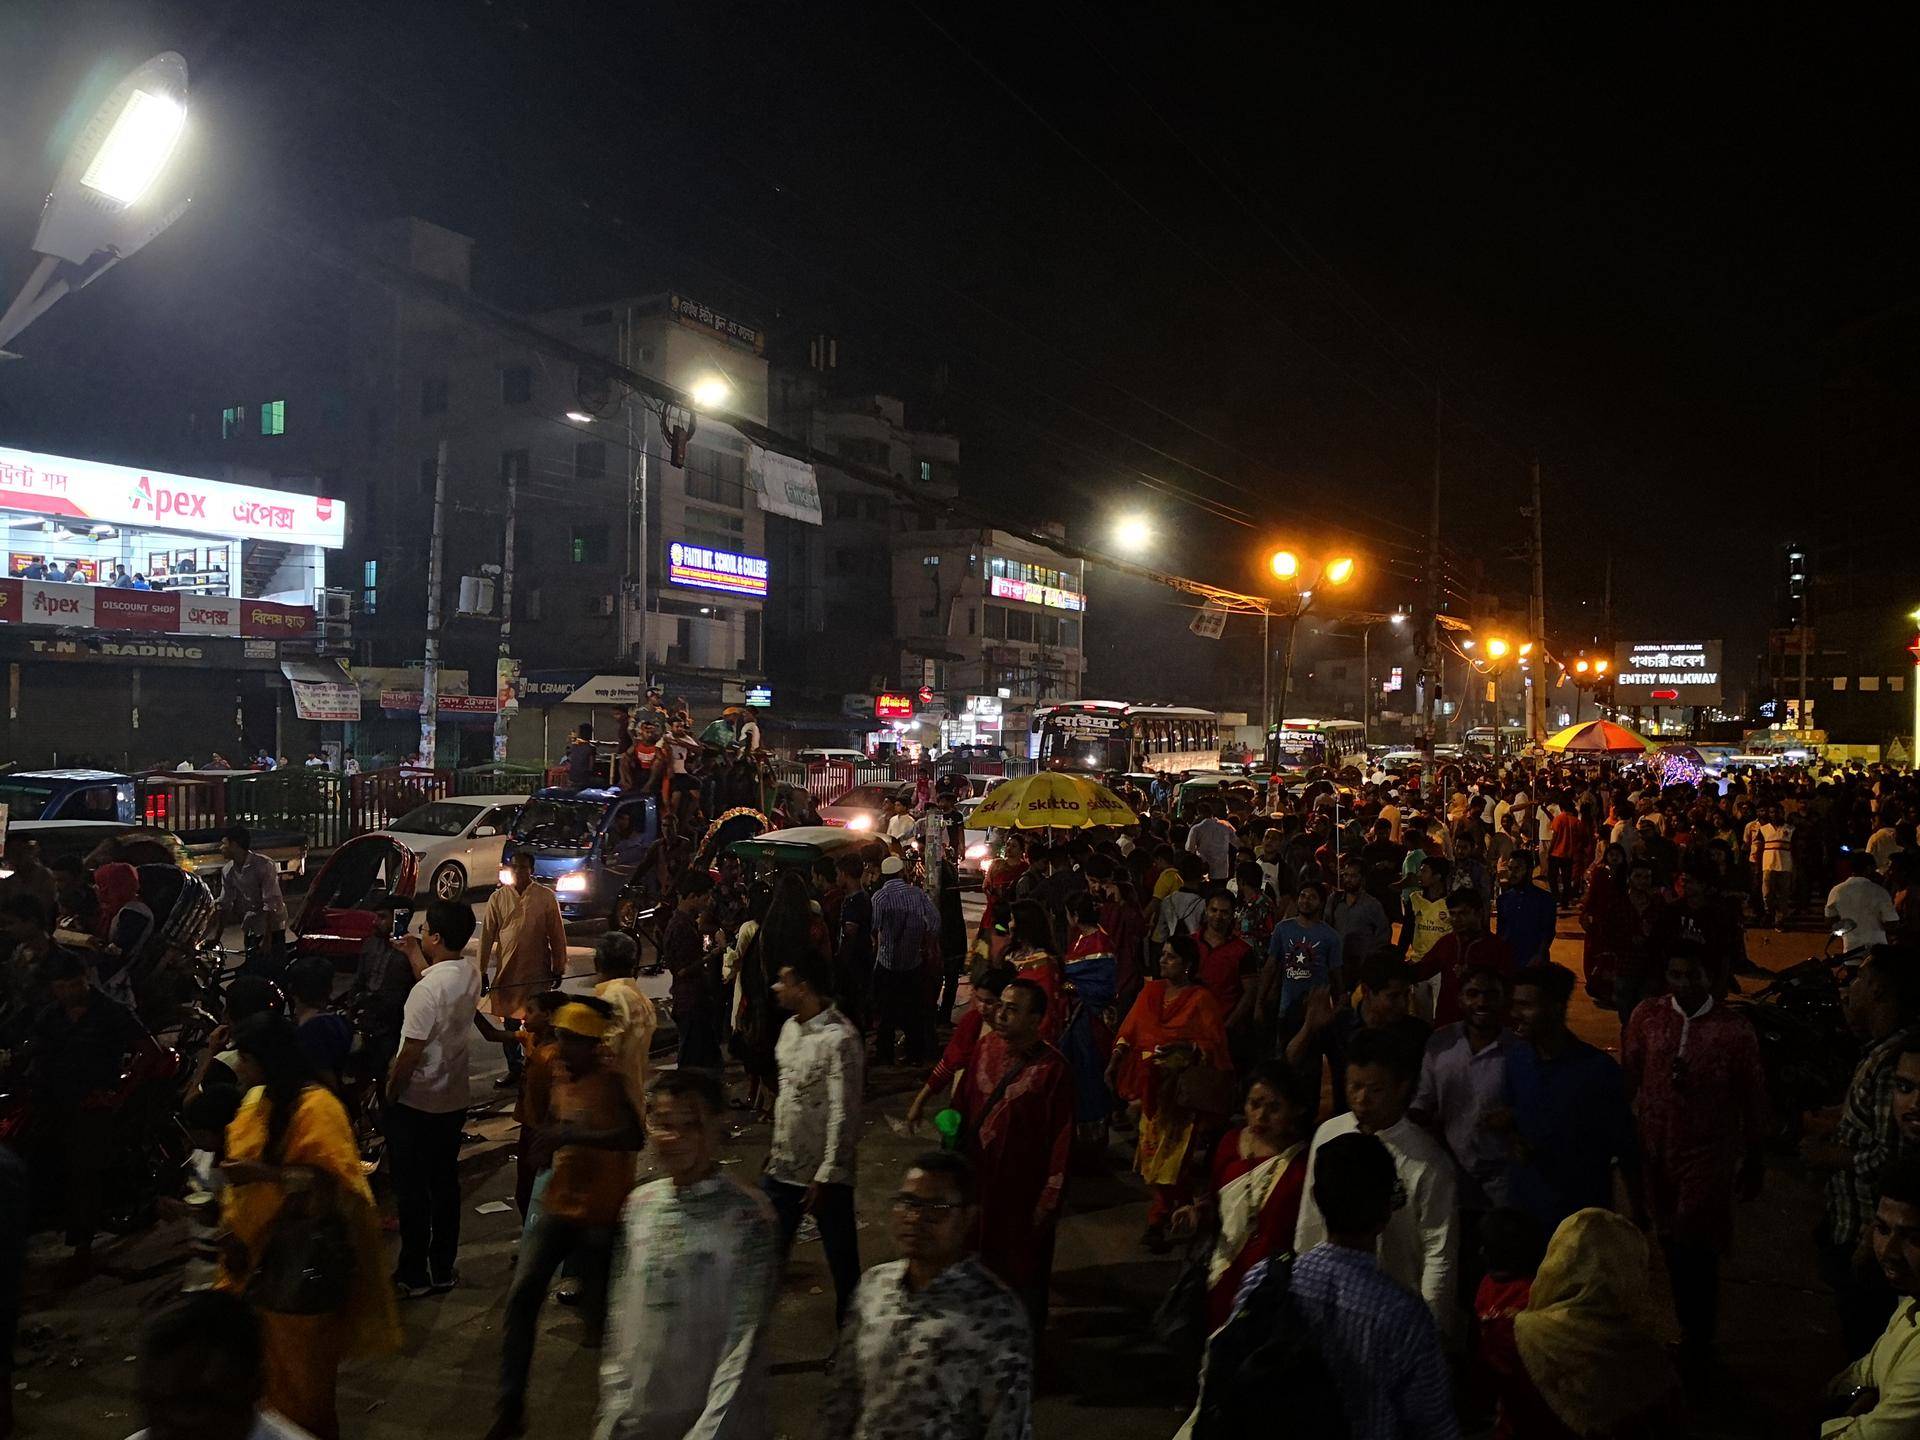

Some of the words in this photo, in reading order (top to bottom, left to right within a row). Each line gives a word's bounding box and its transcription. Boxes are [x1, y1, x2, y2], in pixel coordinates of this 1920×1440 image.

[129, 476, 206, 520] Apex
[233, 501, 295, 529] এপেক্স
[714, 551, 737, 574] SCHOOL
[743, 556, 767, 578] COLLEGE
[33, 591, 79, 616] Apex
[102, 601, 148, 612] DISCOUNT
[152, 605, 175, 614] SHOP
[251, 609, 282, 626] বিশেষ
[90, 643, 202, 659] RADING
[1618, 673, 1657, 685] ENTRY
[1659, 673, 1717, 685] WALKWAY
[541, 682, 575, 694] CERAMICS
[1028, 799, 1080, 811] skitto
